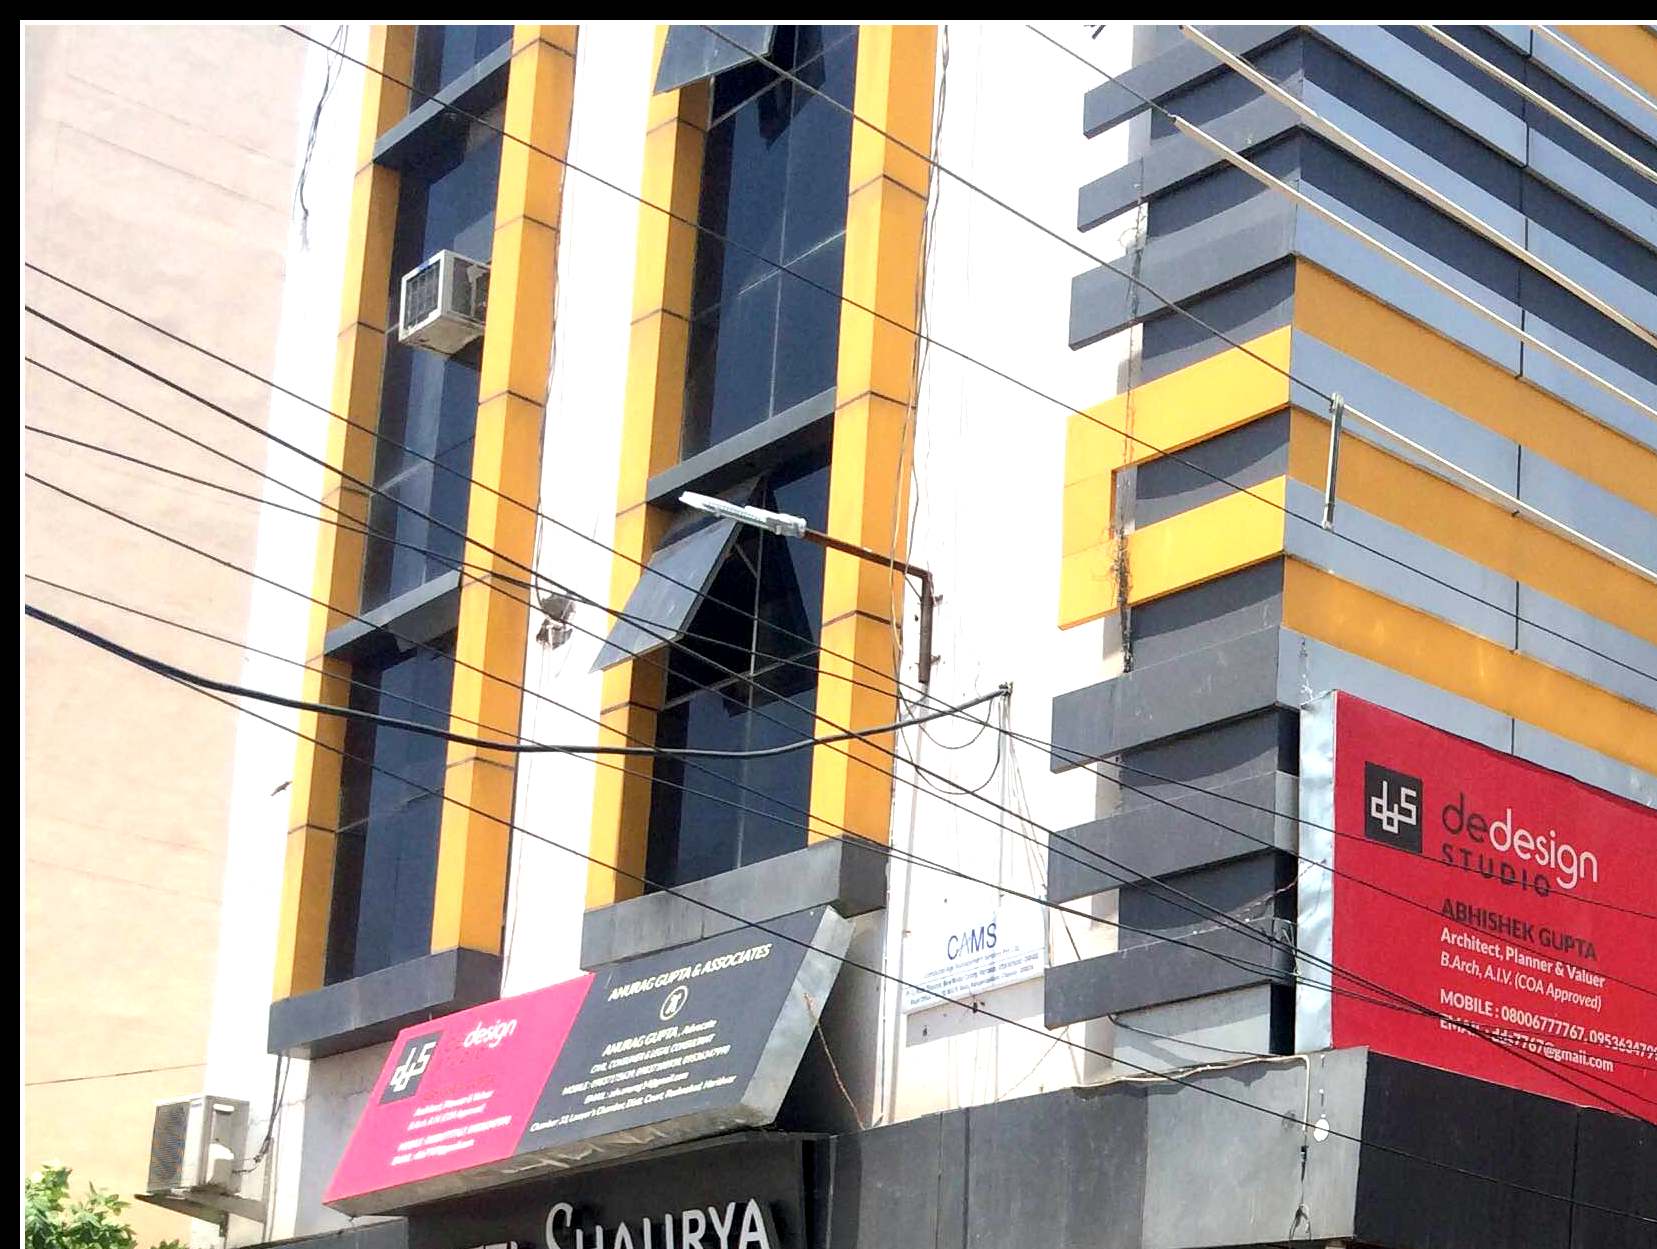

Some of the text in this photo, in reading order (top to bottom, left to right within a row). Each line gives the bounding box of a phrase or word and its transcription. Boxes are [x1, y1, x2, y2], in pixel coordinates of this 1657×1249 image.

[1442, 843, 1550, 897] STUDIO
[947, 922, 997, 960] CAMS
[1442, 898, 1597, 960] ABHISHEK GUPTA
[608, 976, 655, 1001] ANURAG
[655, 966, 691, 988] GUPTA
[702, 944, 773, 974] ASSOCIATES
[1440, 928, 1605, 987] Architect, Planner & Valuer
[1440, 988, 1492, 1017] MOBILE
[1515, 974, 1544, 994] (COA
[1546, 980, 1602, 1012] Approved)
[463, 1018, 517, 1048] design
